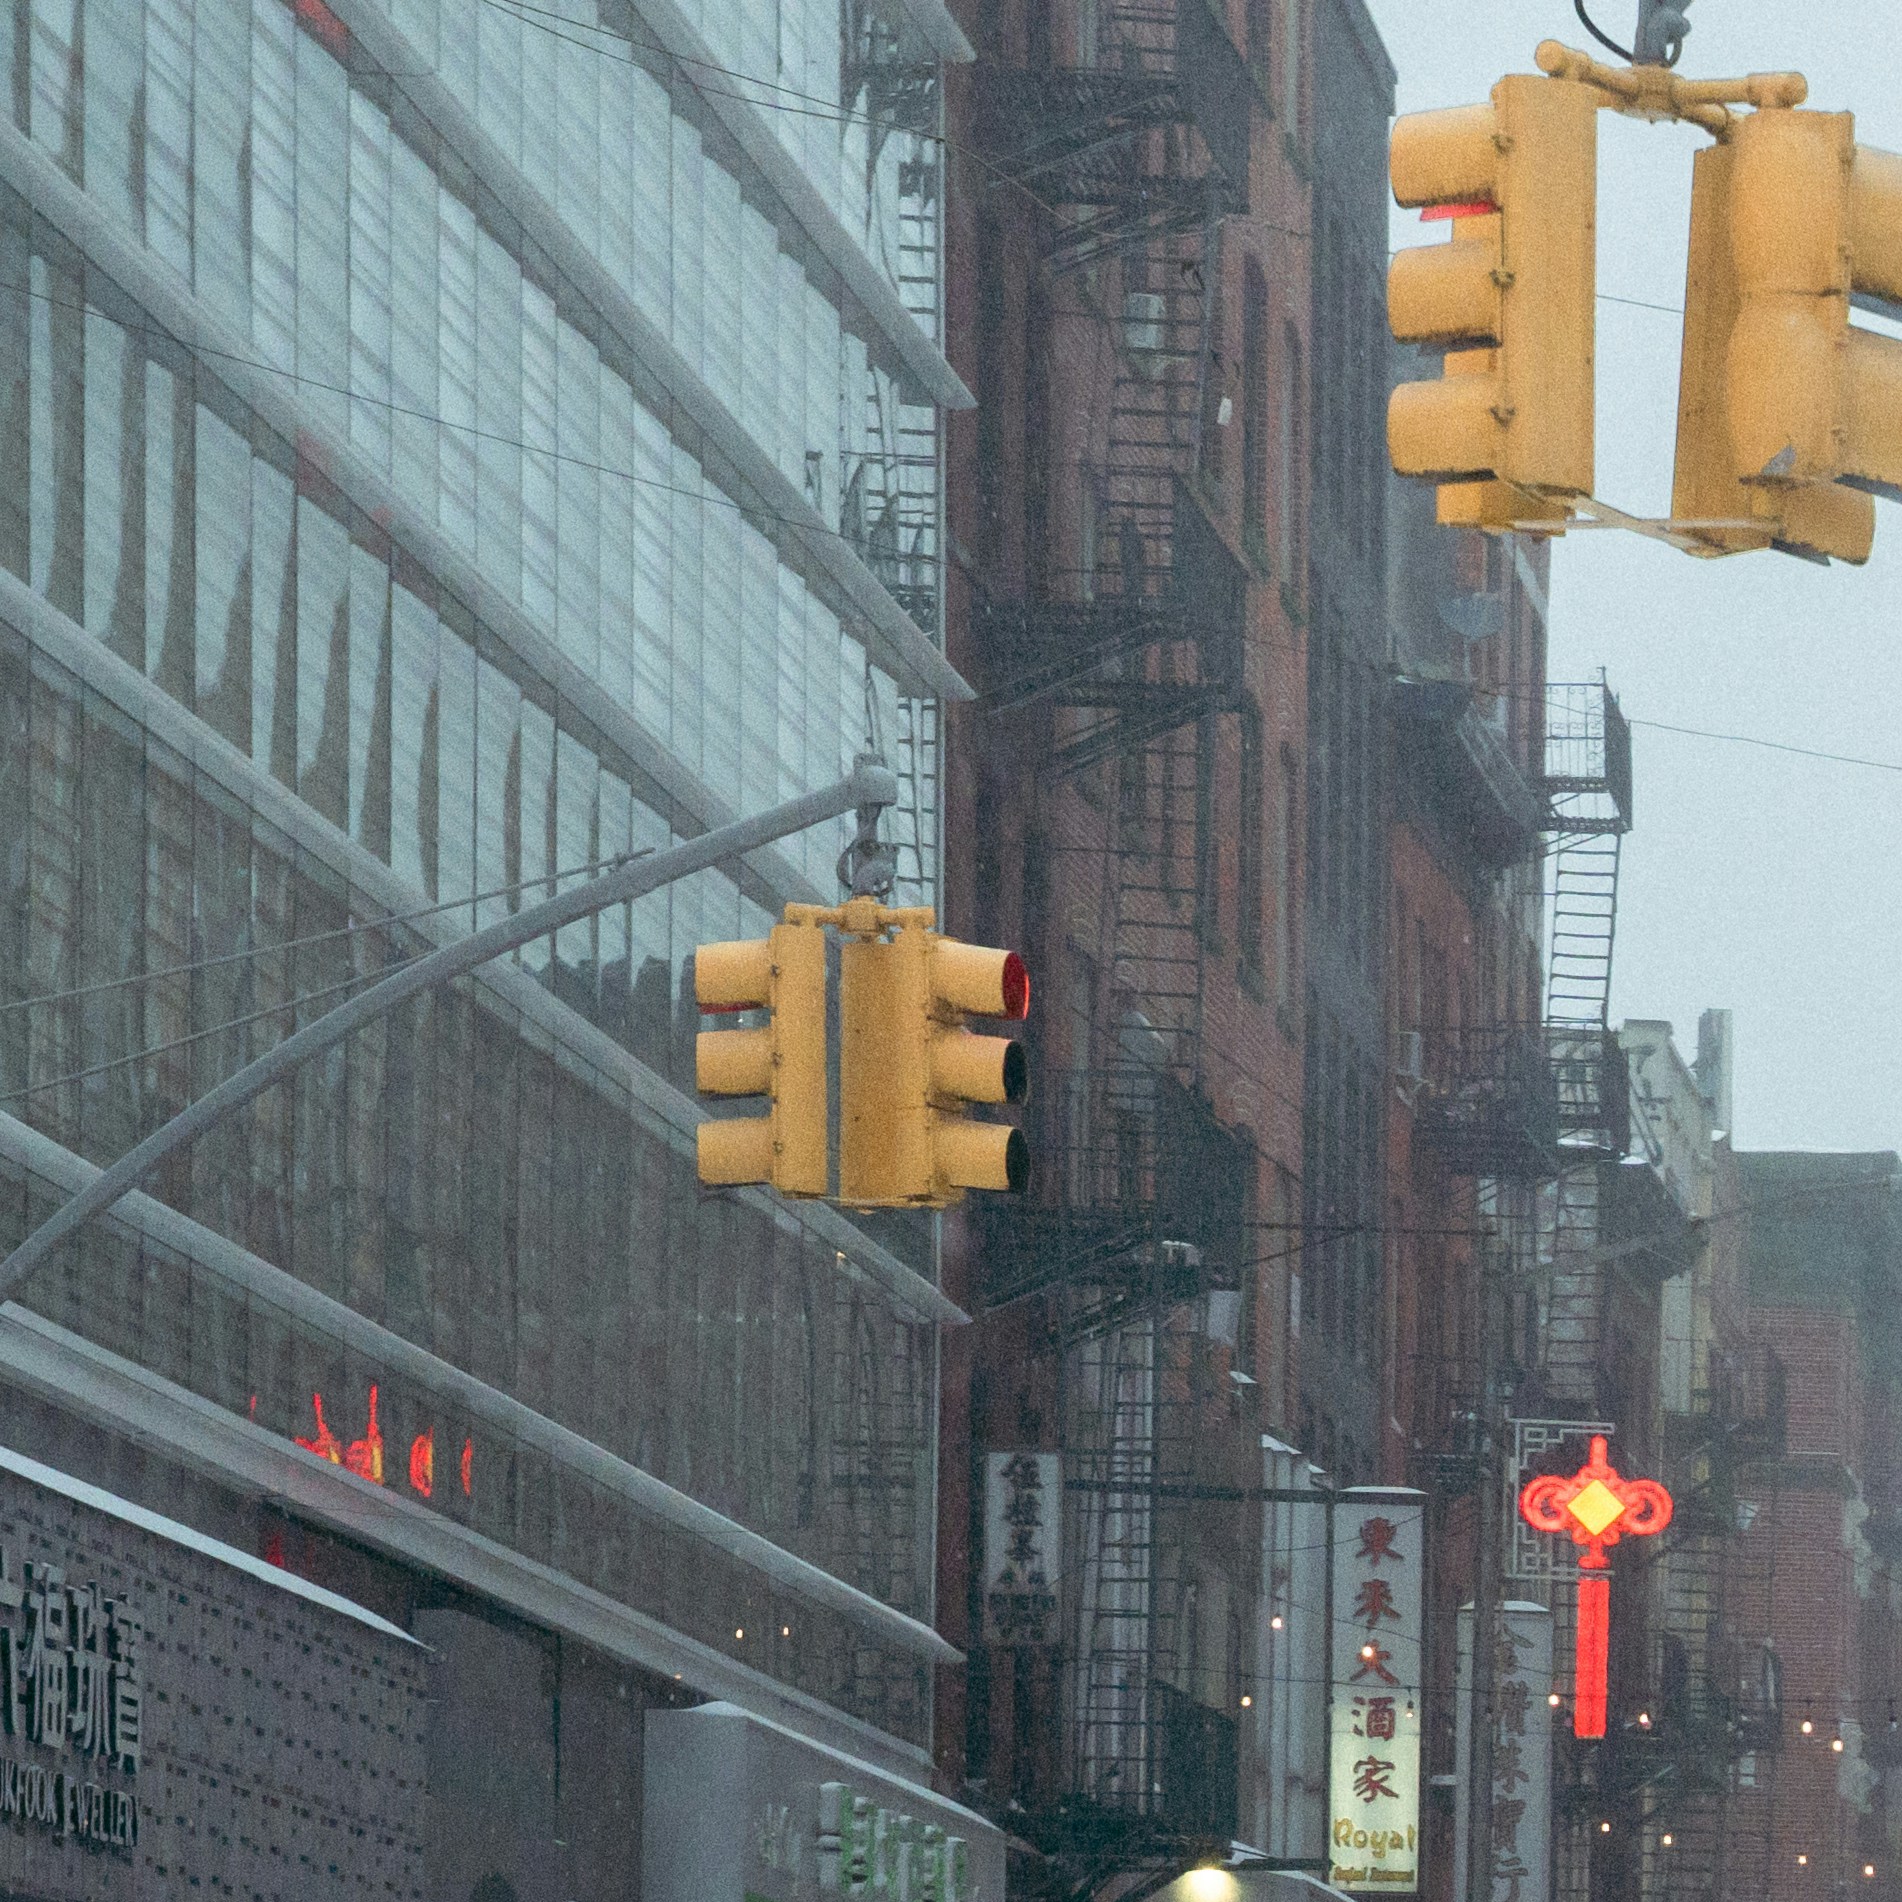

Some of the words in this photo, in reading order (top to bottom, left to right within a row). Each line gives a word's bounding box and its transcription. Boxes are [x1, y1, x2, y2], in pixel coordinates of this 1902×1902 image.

[1349, 1516, 1404, 1803] 東來大酒家
[1333, 1817, 1416, 1860] Royal
